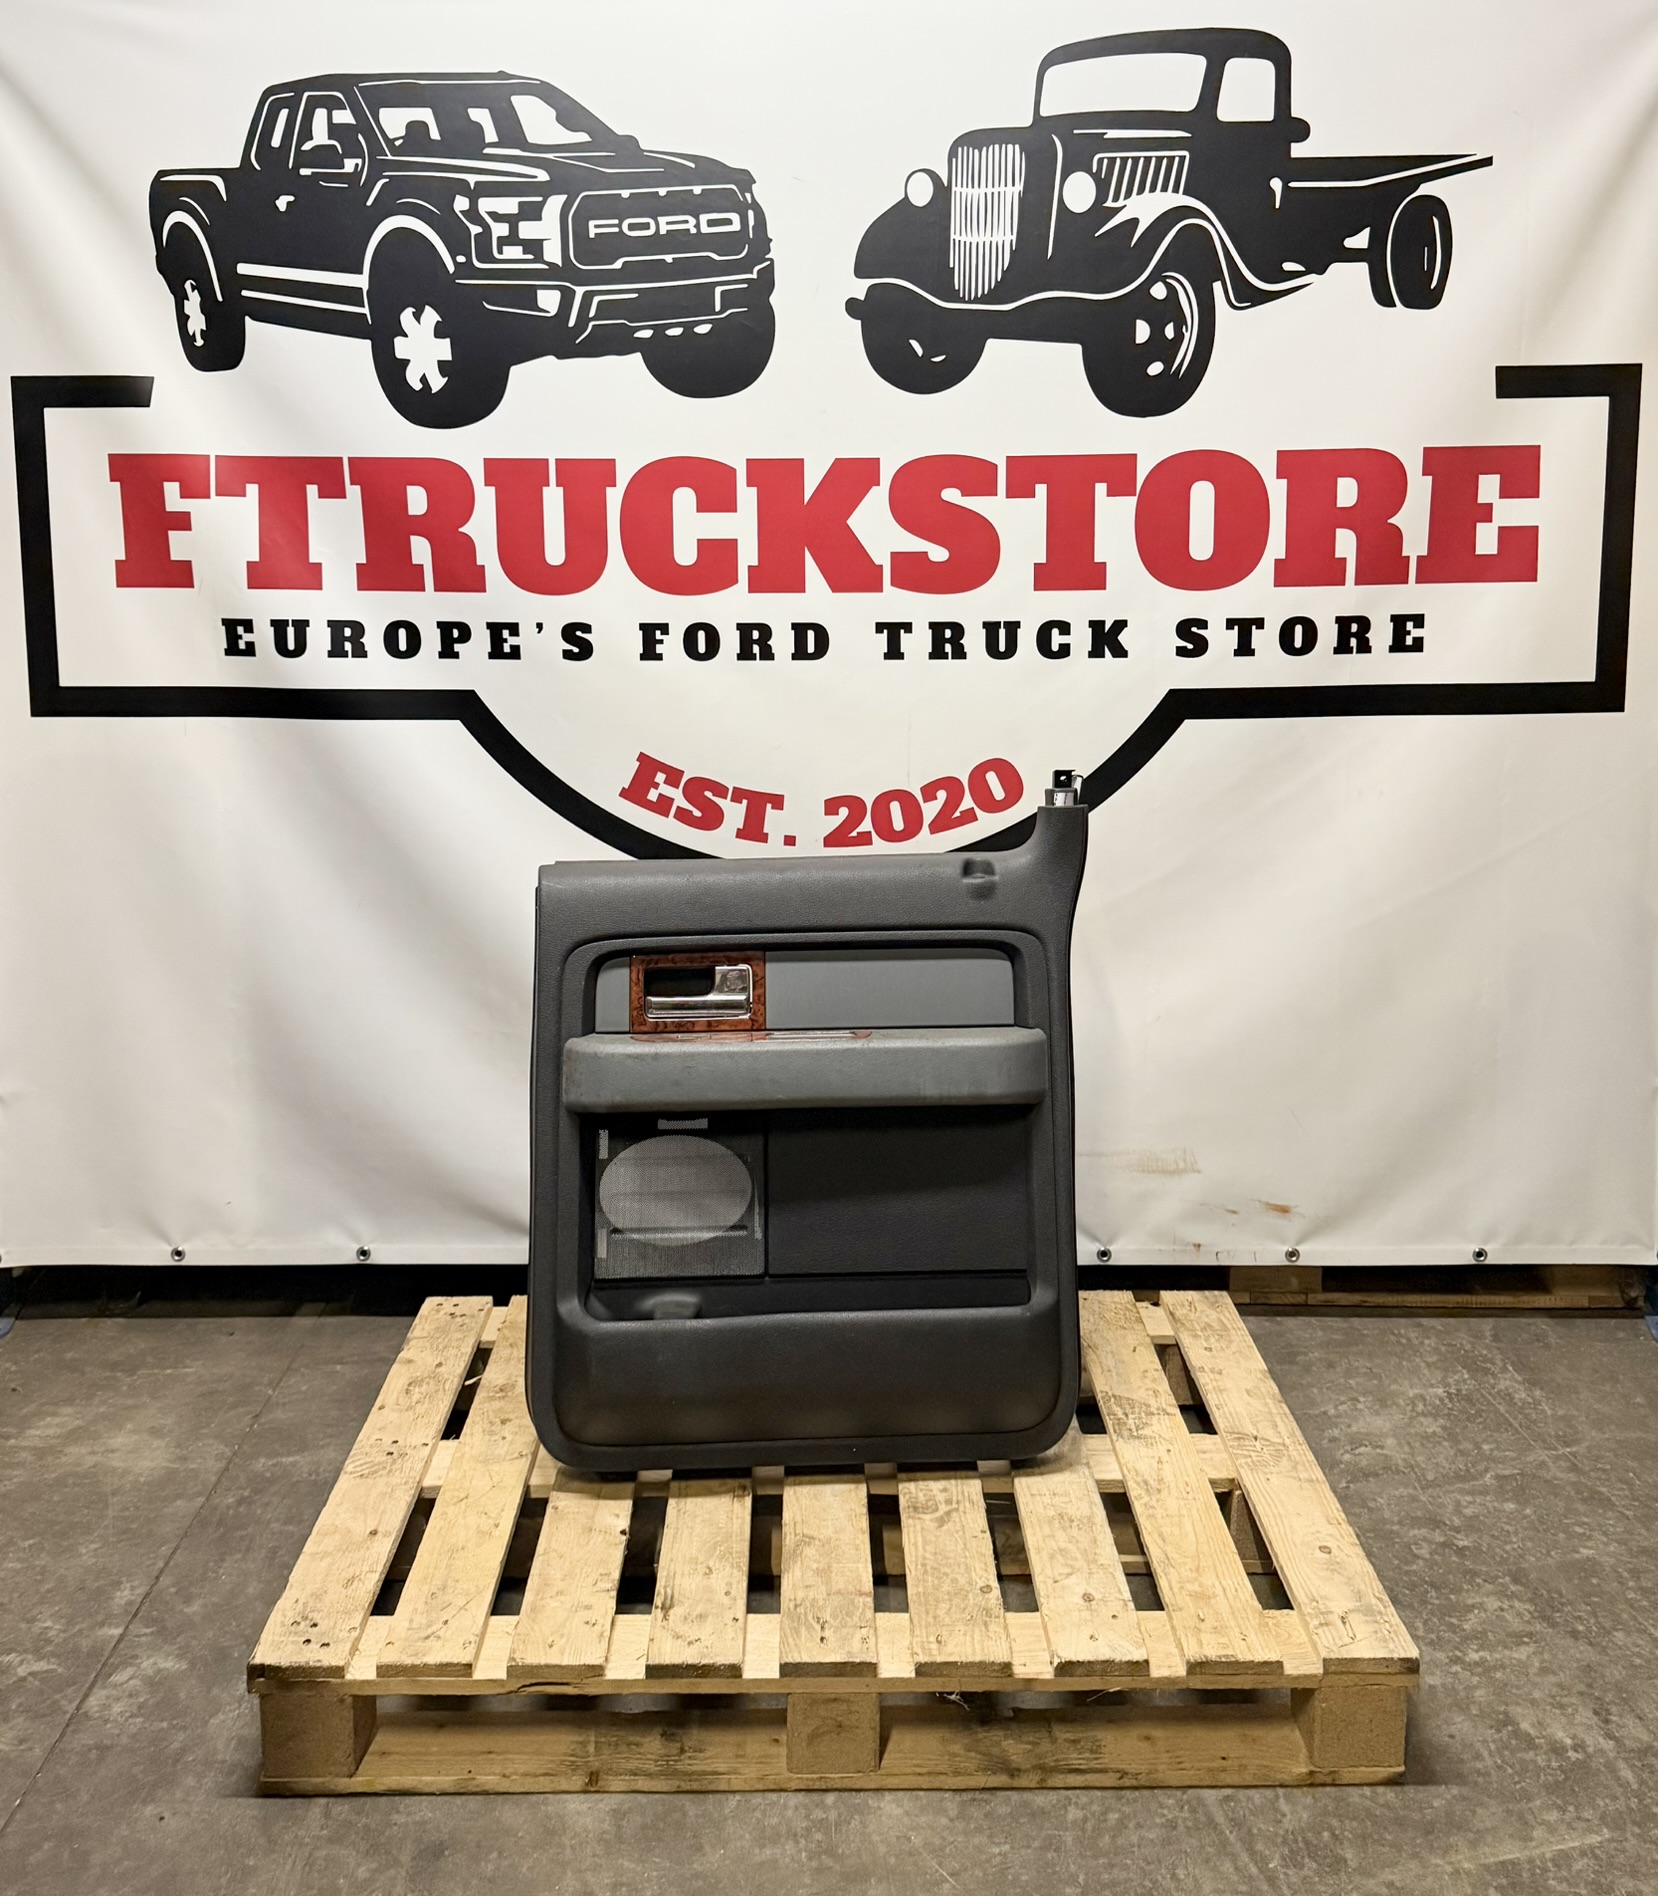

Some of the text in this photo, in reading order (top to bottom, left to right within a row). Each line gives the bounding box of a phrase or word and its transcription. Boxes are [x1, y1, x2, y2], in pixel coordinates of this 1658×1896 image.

[589, 213, 741, 238] FORD
[108, 445, 1541, 596] FTRUCKSTORE
[221, 614, 1424, 661] EUROPE'S FORD TRUCK STORE
[620, 753, 1024, 848] EST. 2020
